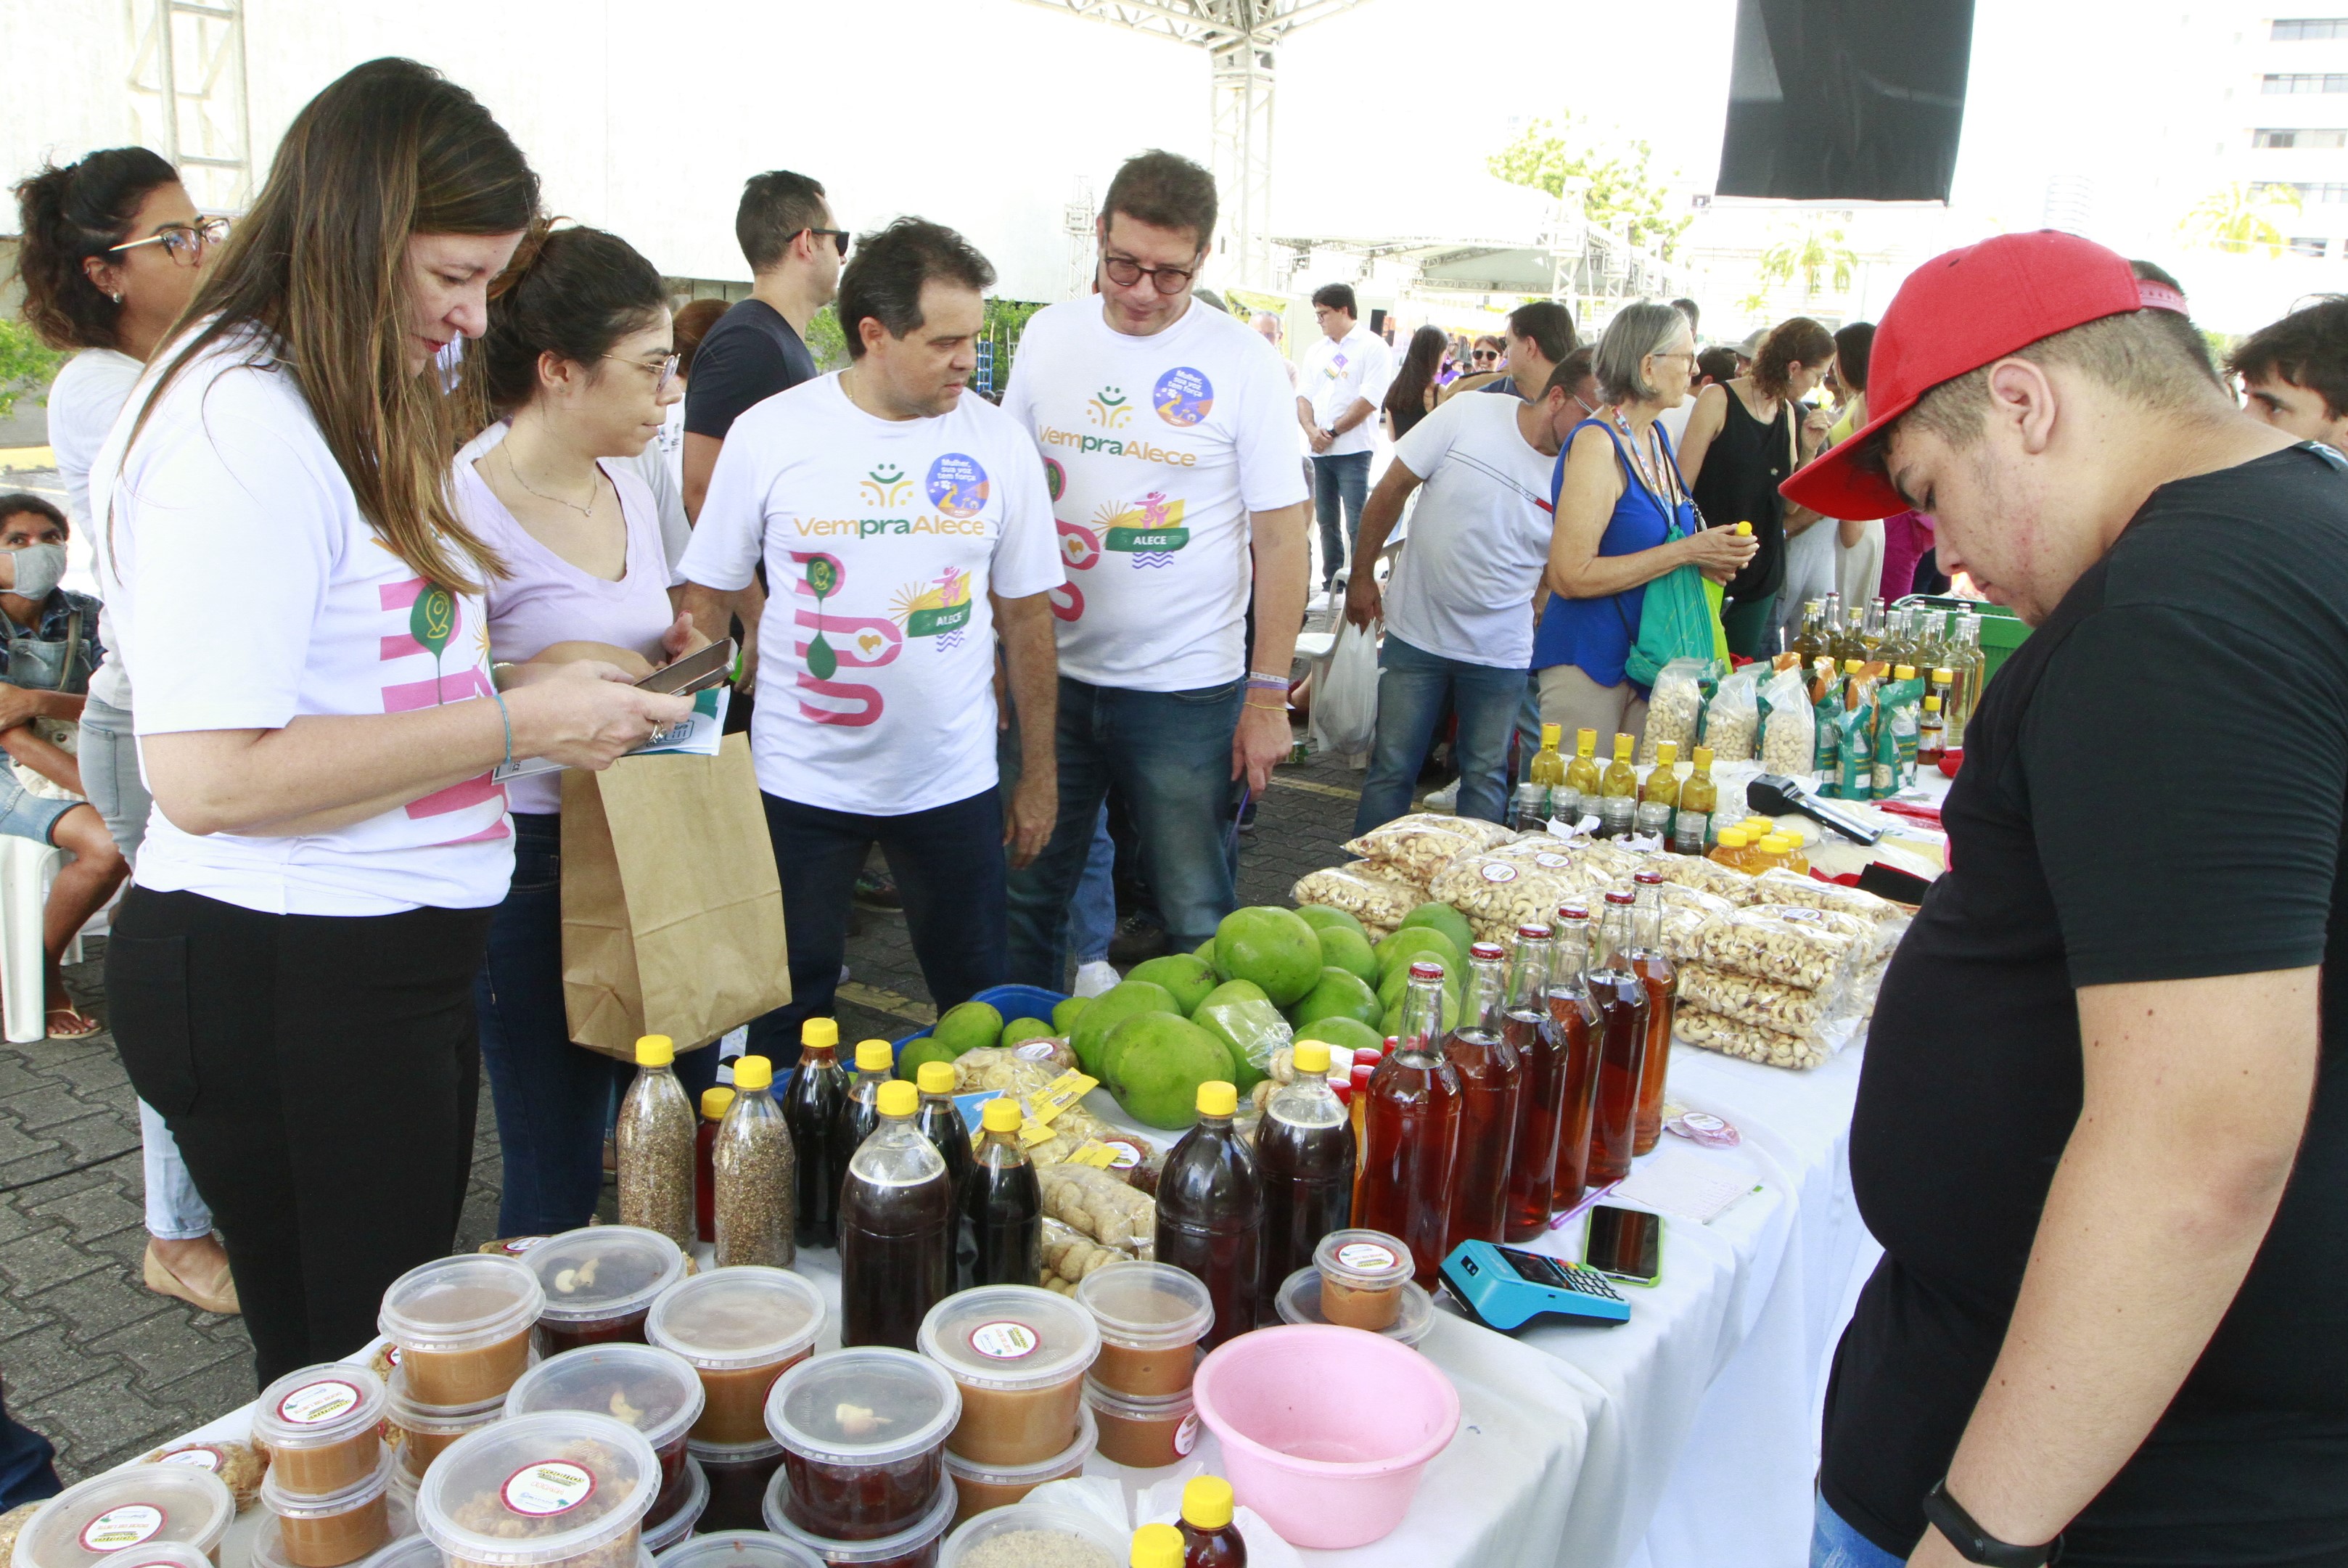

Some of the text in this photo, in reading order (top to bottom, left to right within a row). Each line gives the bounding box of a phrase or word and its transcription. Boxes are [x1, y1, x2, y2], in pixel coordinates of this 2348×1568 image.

[1173, 377, 1202, 390] sua voz
[1175, 370, 1202, 385] Mulher,
[1167, 381, 1203, 398] tem força
[1039, 424, 1196, 467] VempraAlece
[941, 459, 972, 468] Mulher,
[954, 472, 976, 482] força
[794, 515, 985, 539] VempraAlece
[1133, 535, 1167, 546] ALECE
[936, 612, 962, 627] ALECE
[538, 1468, 584, 1483] PRODUTOS
